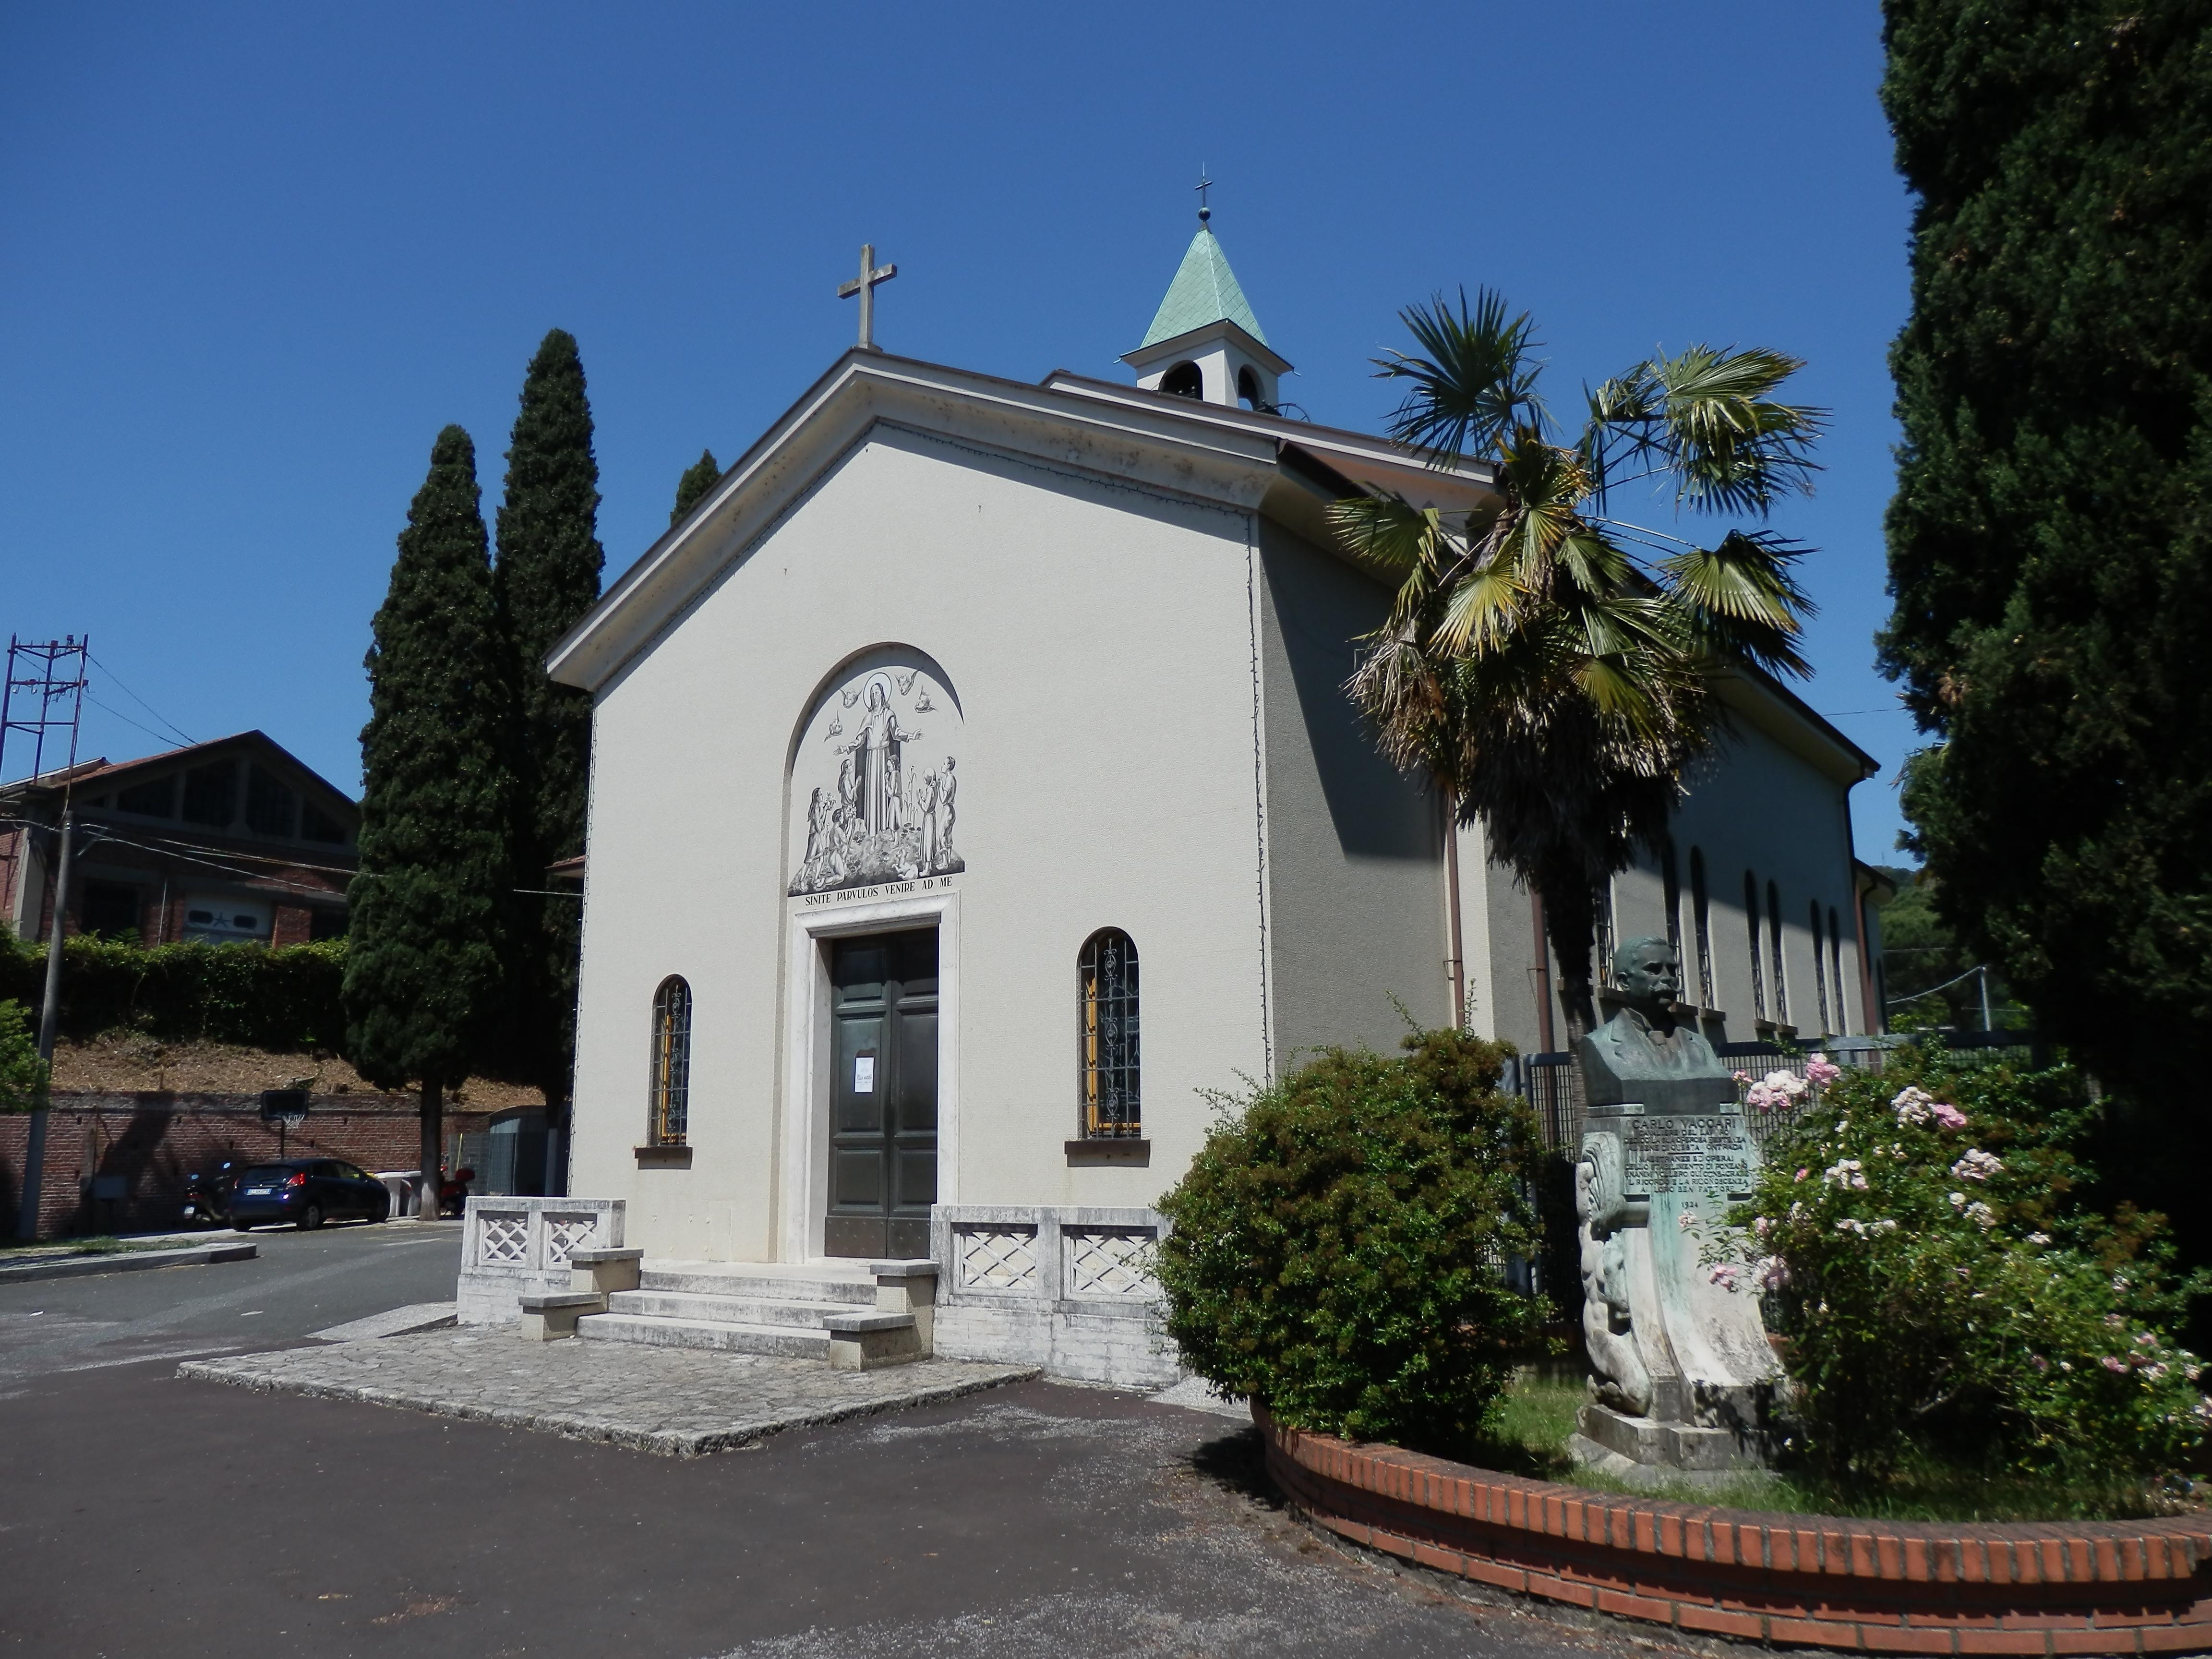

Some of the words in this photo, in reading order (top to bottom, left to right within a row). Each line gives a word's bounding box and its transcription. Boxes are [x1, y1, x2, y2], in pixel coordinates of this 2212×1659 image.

[805, 893, 831, 906] SINITE
[837, 887, 879, 902] PARVULOS
[885, 881, 915, 895] VENIRE
[922, 879, 933, 890] AD
[939, 876, 952, 888] ME
[1632, 1119, 1673, 1129] CARLO
[1680, 1118, 1736, 1129] VACCARI
[1681, 1201, 1698, 1209] 1924
